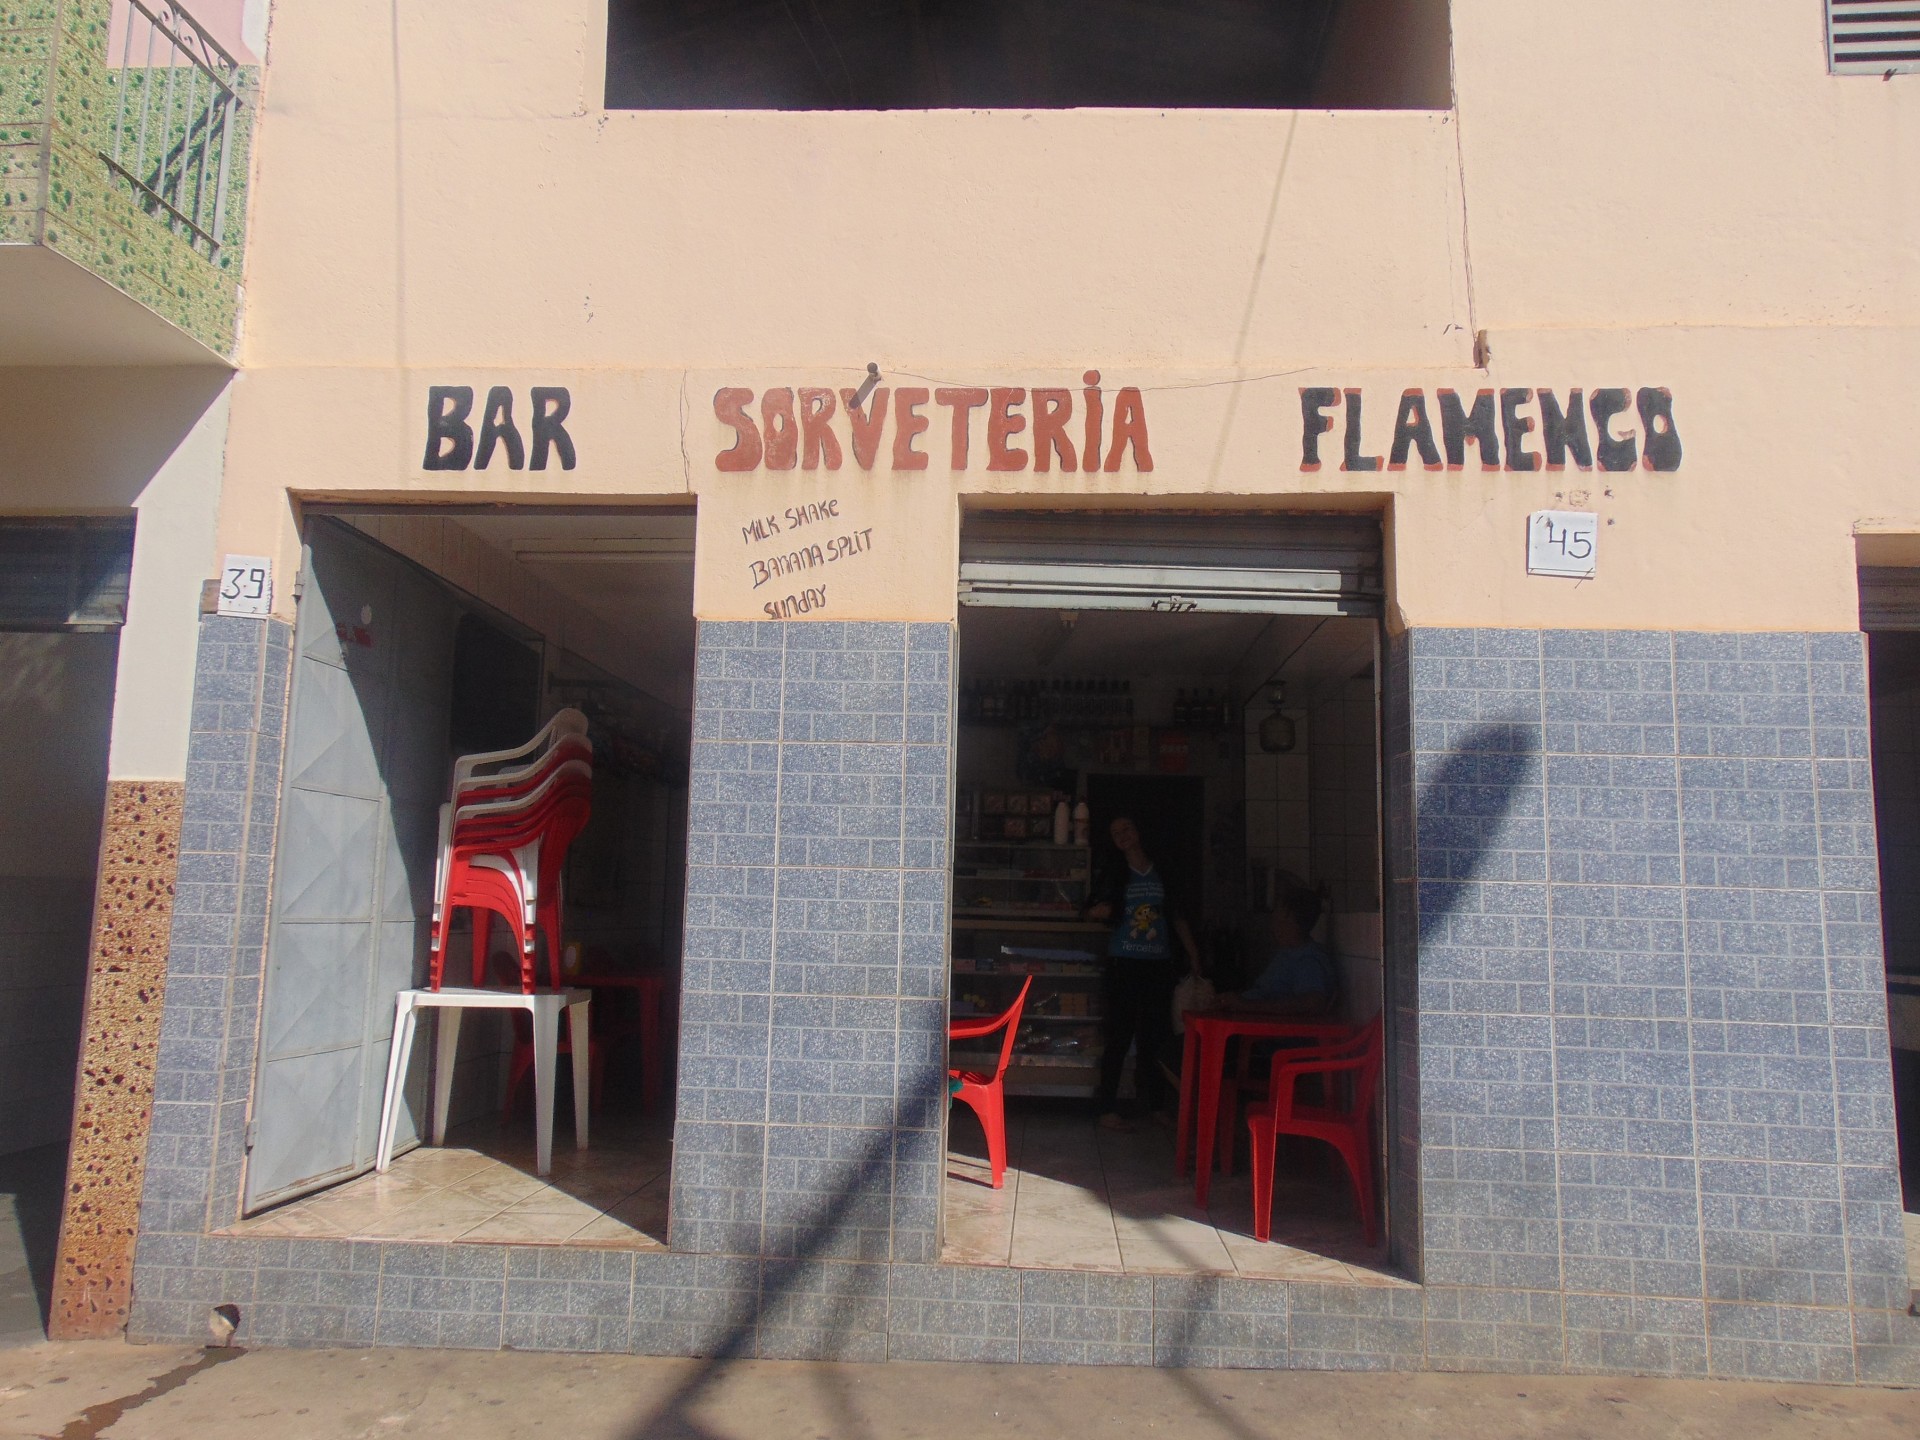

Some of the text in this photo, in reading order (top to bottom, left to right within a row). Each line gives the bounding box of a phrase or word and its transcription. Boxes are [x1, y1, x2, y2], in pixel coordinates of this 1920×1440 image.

[422, 369, 1683, 472] BAR SORVETERIA FLAMENGO
[741, 499, 840, 545] MILK SHAKE
[1546, 517, 1592, 559] 45
[748, 527, 873, 590] BANANA SPLIT
[220, 568, 265, 600] 39
[763, 583, 827, 620] SUNDAY
